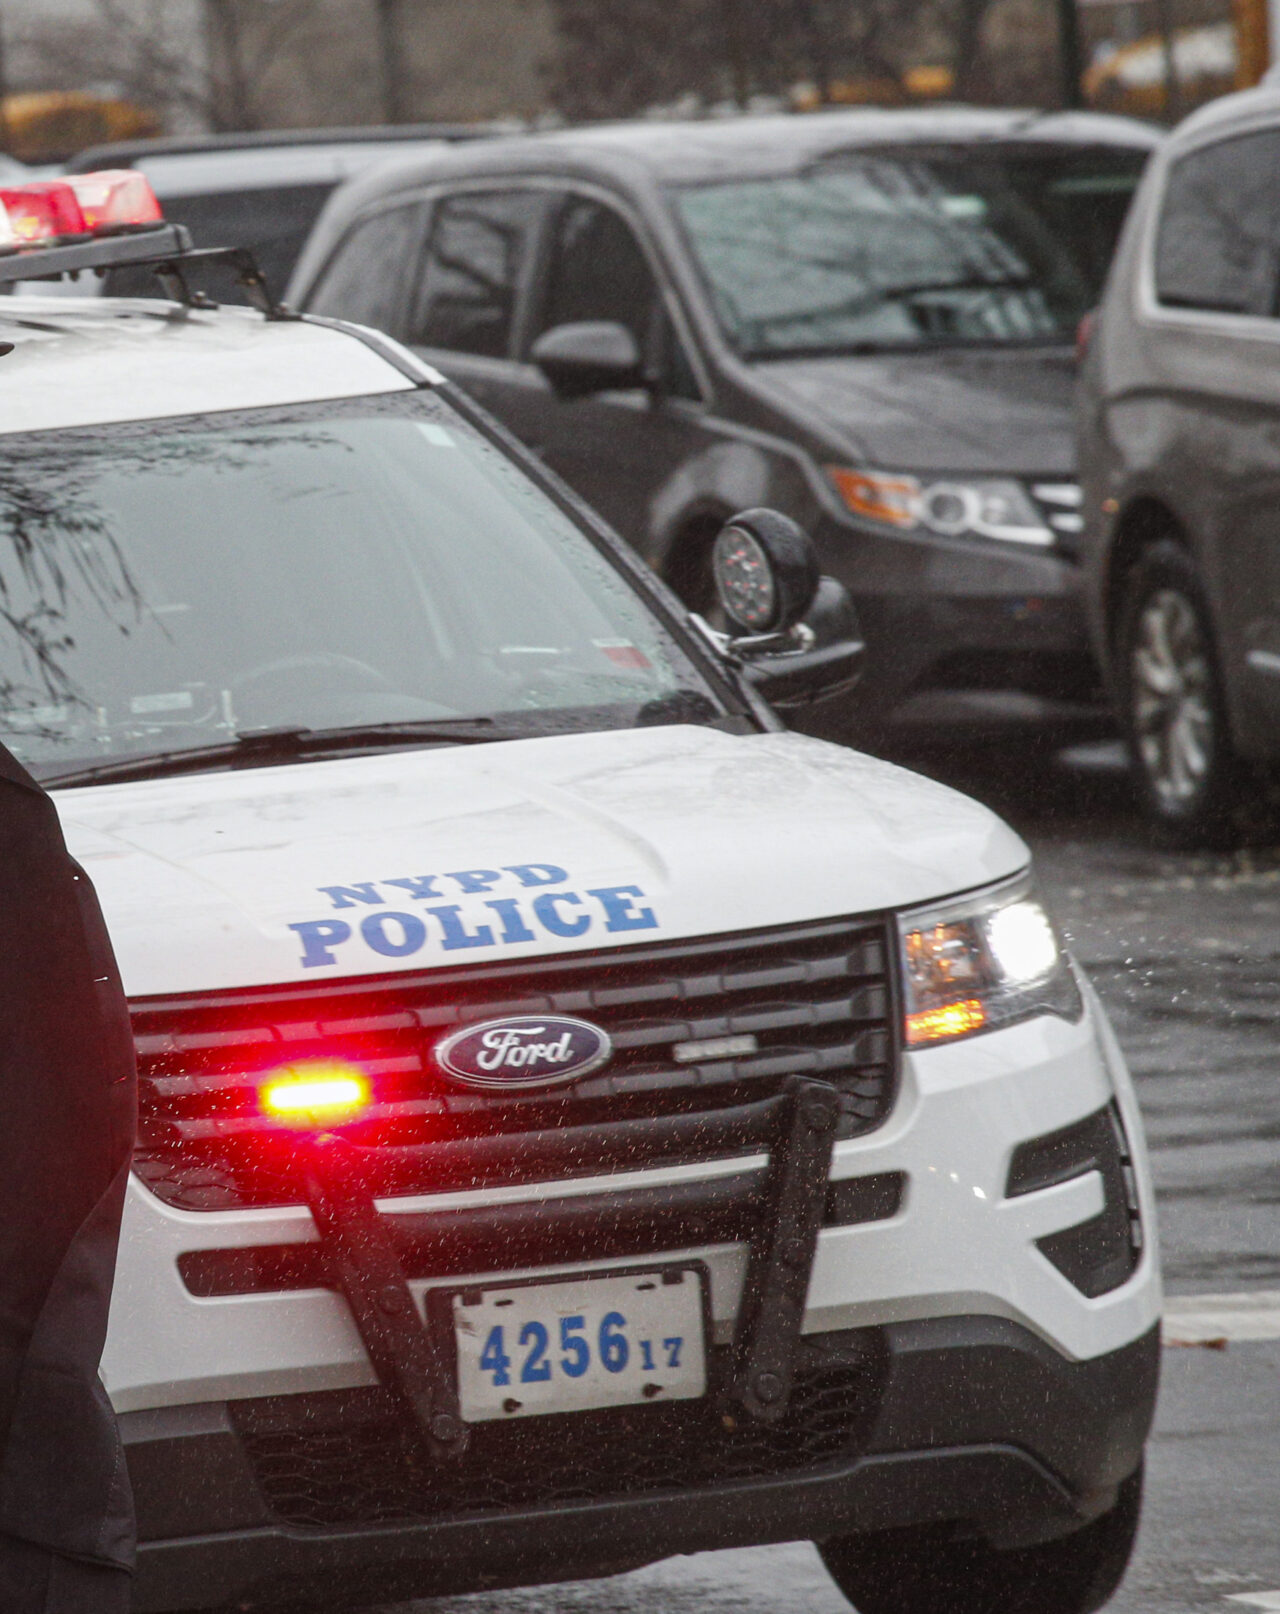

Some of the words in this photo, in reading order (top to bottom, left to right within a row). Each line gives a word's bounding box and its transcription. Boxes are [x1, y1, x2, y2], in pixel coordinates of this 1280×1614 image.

[317, 863, 569, 909] NYPD
[287, 885, 659, 968] POLICE
[476, 1026, 574, 1071] Ford
[480, 1311, 629, 1387] 4256
[639, 1337, 684, 1371] 17
